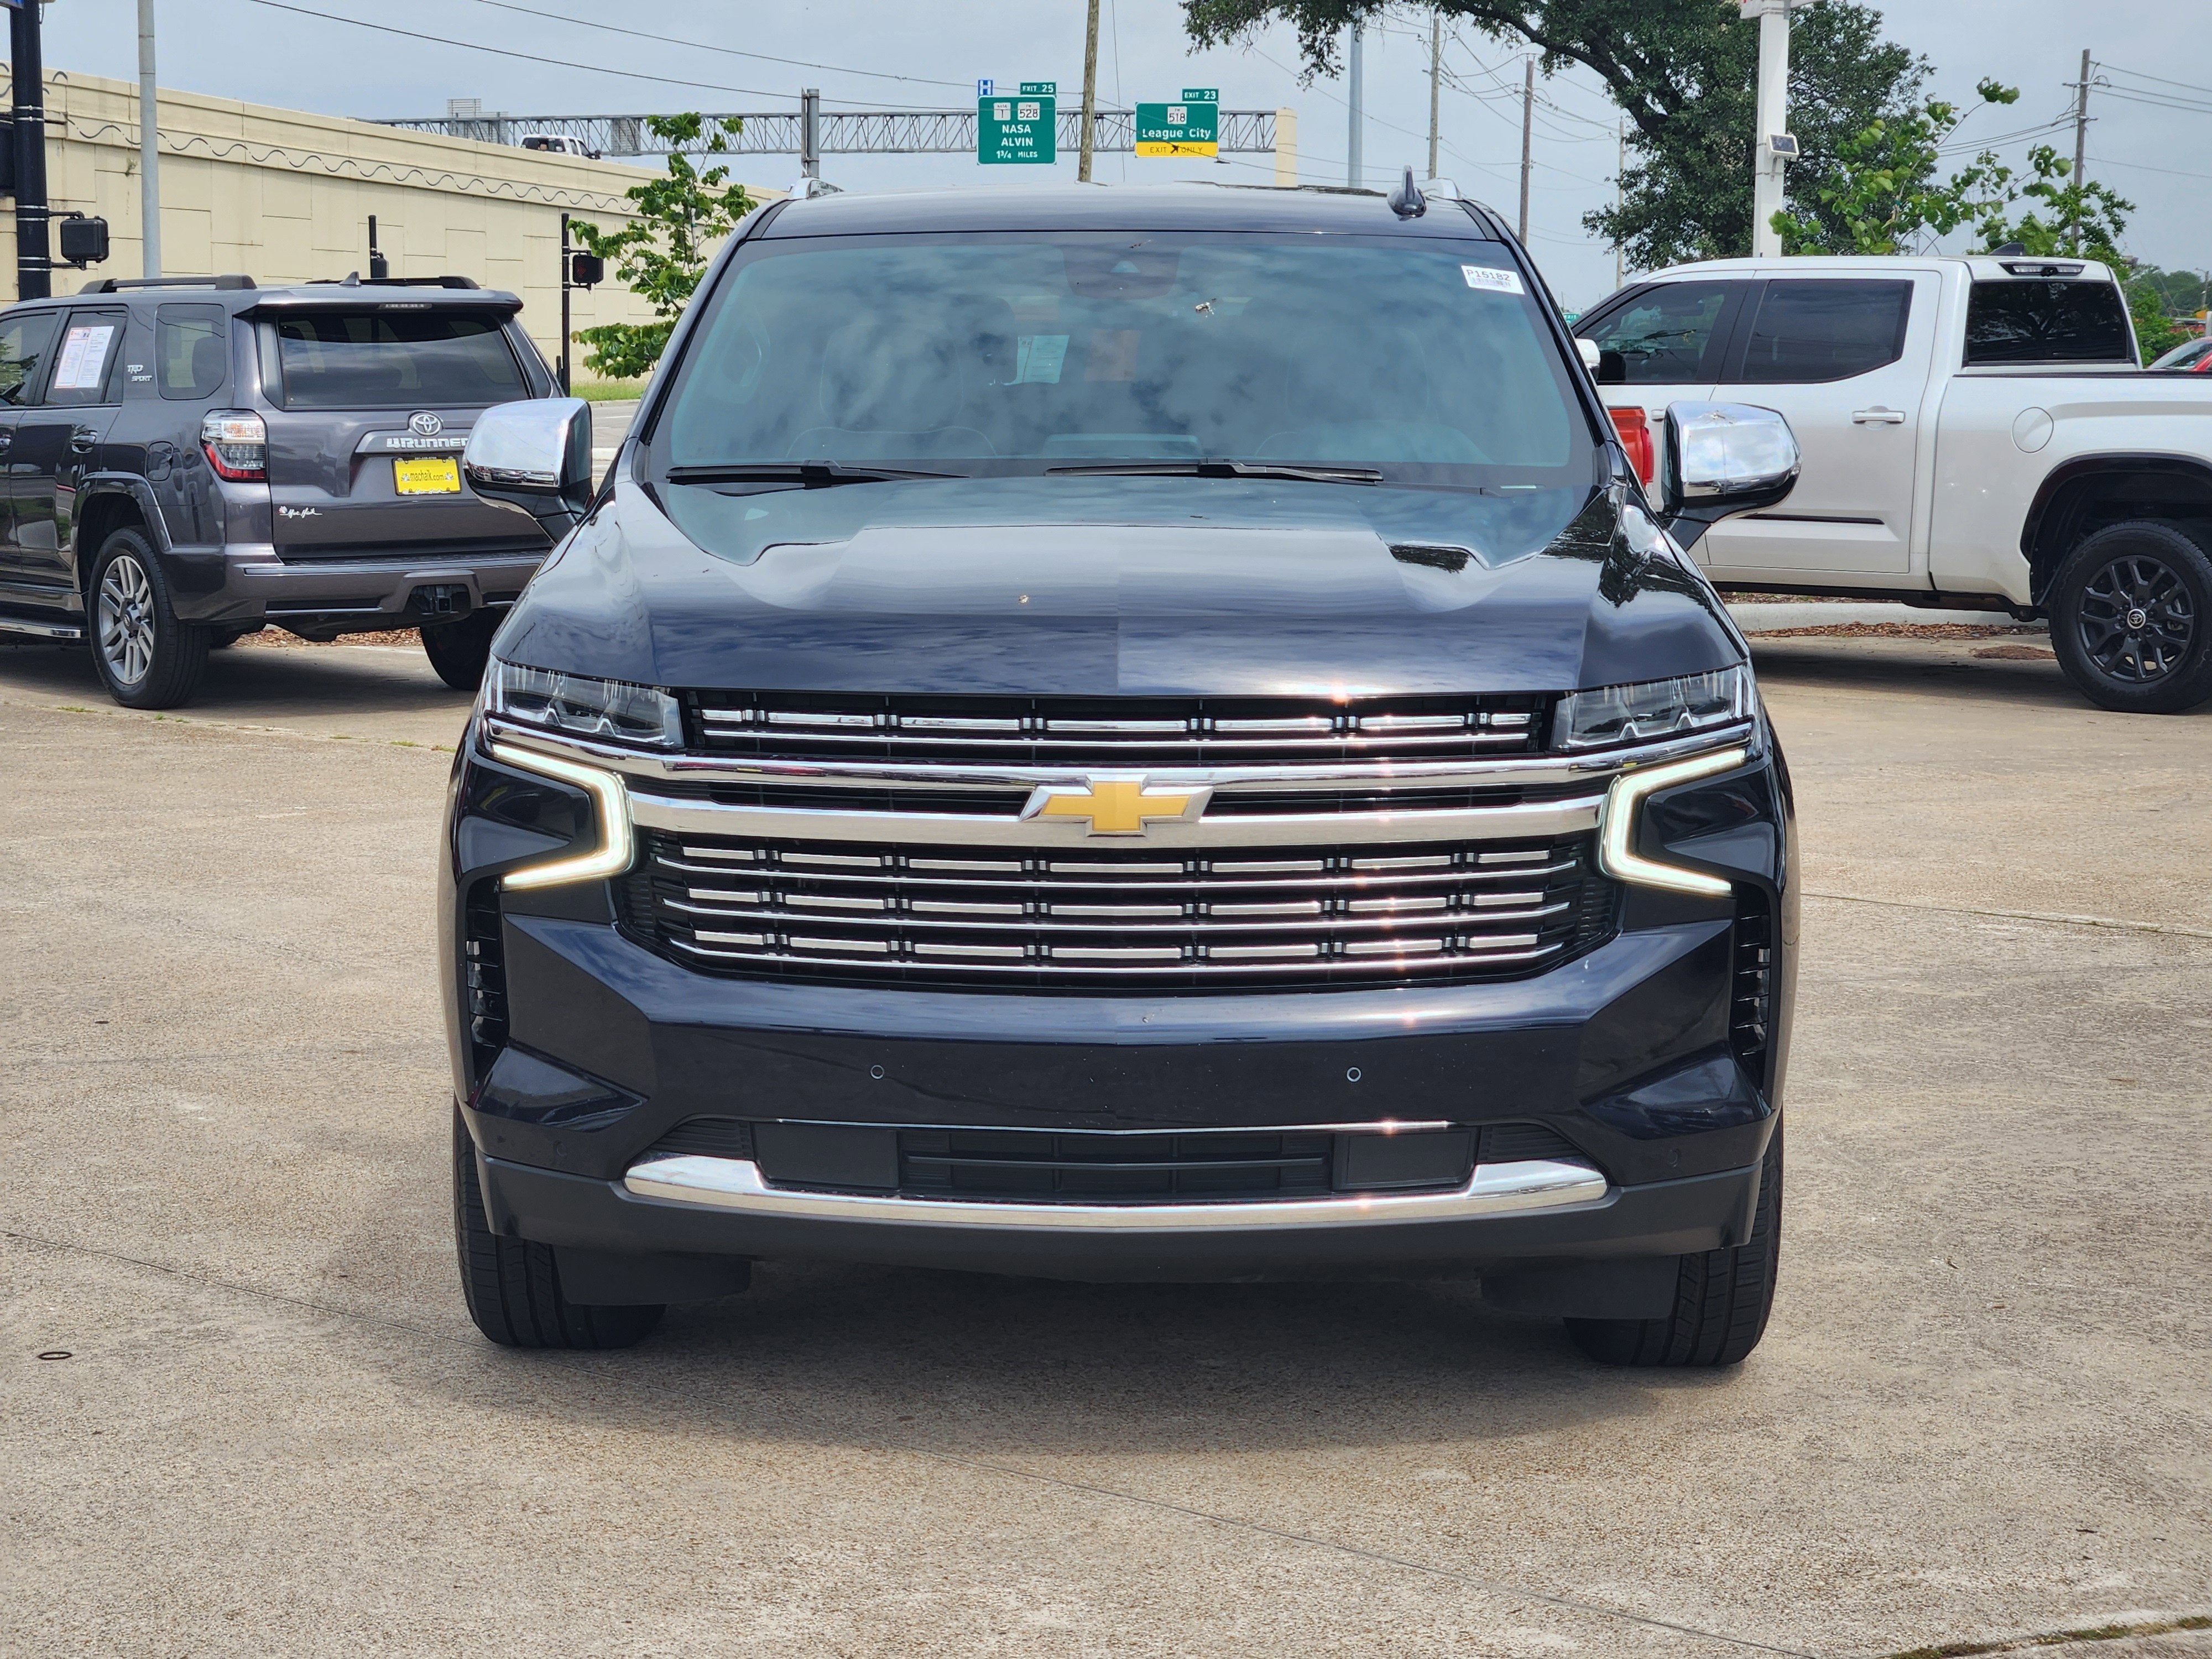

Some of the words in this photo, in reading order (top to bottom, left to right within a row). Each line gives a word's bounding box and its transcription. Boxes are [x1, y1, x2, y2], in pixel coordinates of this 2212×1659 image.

[979, 80, 992, 95] H
[1042, 85, 1054, 93] 25
[1204, 91, 1216, 100] 23
[1019, 109, 1038, 118] 528
[1169, 113, 1186, 122] 518
[1002, 124, 1031, 134] NASA
[1142, 128, 1183, 140] League
[1188, 127, 1211, 140] City
[1001, 137, 1033, 147] ALVIN
[1467, 269, 1511, 281] P15182
[127, 364, 144, 374] TRD
